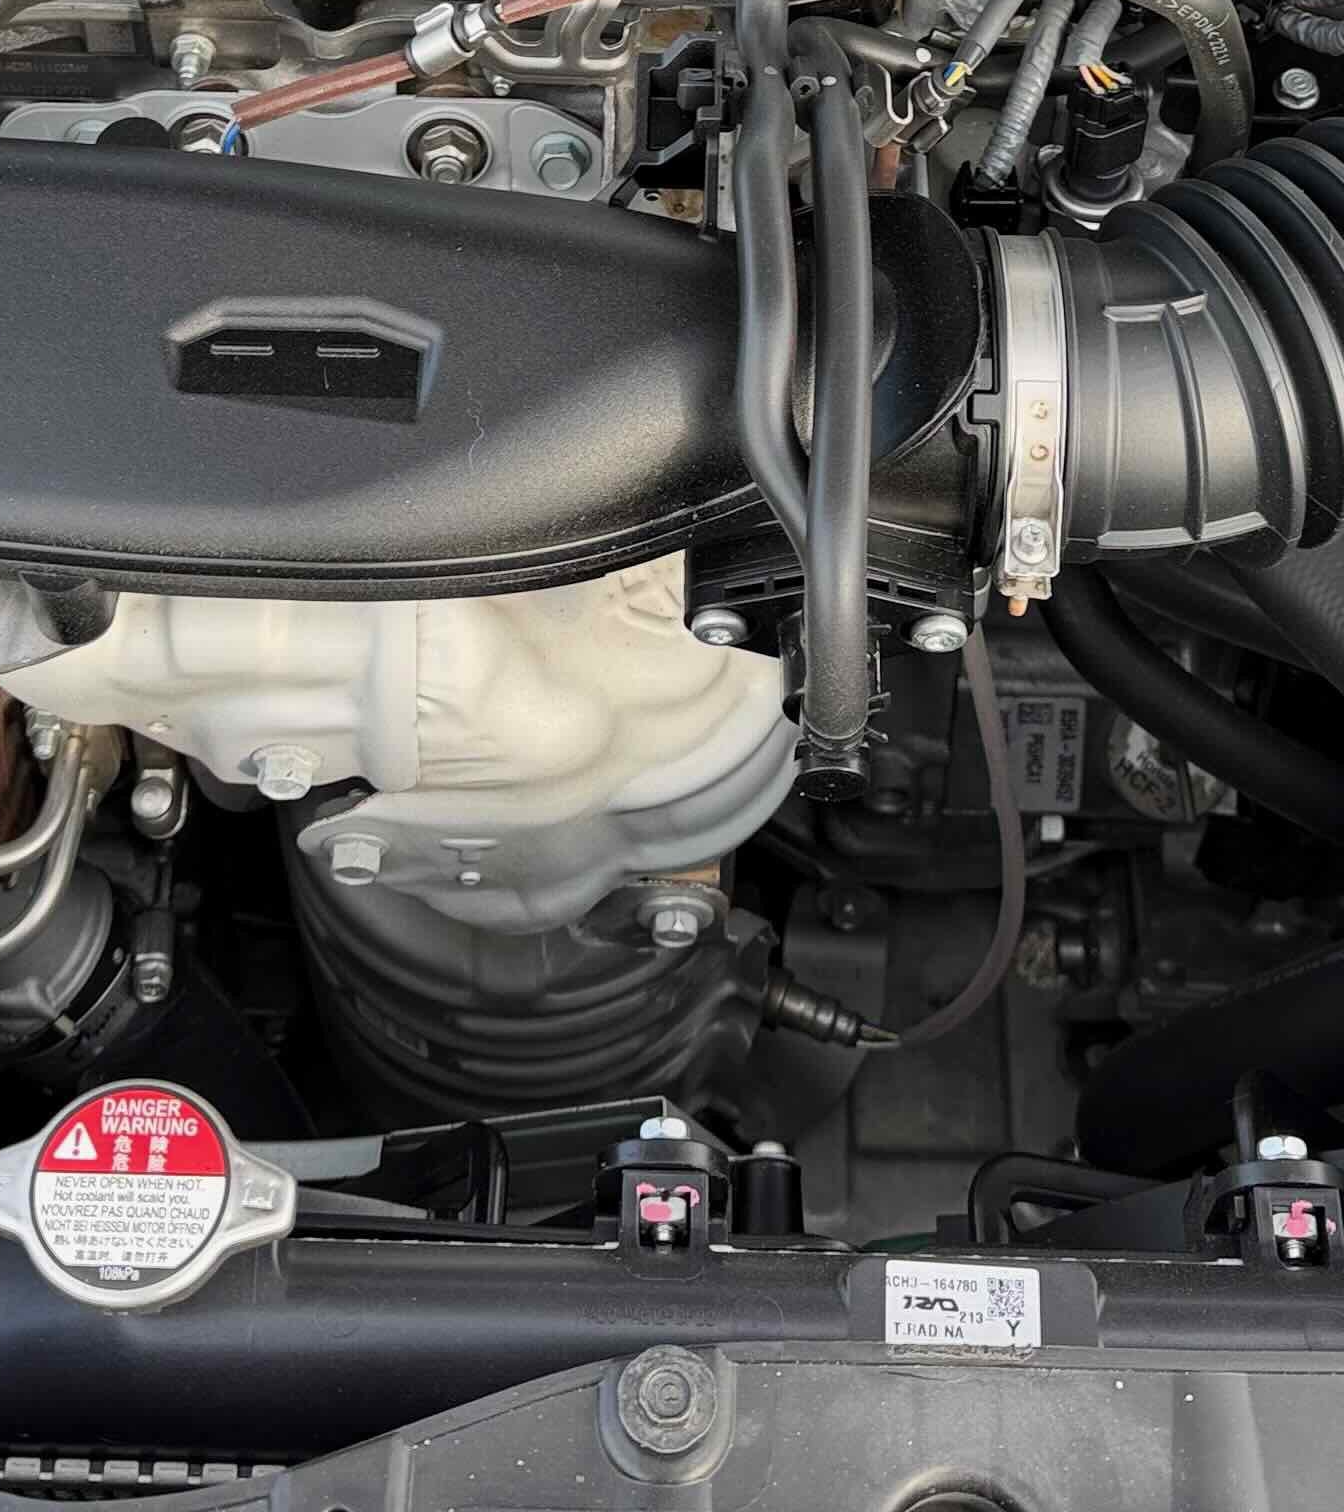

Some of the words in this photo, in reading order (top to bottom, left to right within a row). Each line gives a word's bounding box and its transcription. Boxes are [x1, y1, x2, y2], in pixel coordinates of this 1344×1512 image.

[102, 1098, 183, 1117] DANGER
[101, 1116, 199, 1136] WARNUNG
[55, 1175, 97, 1188] NEVER
[99, 1176, 134, 1189] OPEN
[137, 1177, 174, 1190] WHEN
[53, 1191, 72, 1201] Hot
[76, 1192, 114, 1202] coolant
[117, 1193, 135, 1202] will
[101, 1205, 124, 1217] PAS
[126, 1206, 167, 1219] QUAND
[169, 1207, 210, 1220] CHAUD
[44, 1219, 72, 1231] NICHT
[73, 1220, 88, 1231] BEI
[90, 1221, 130, 1233] HEISSEM
[132, 1221, 164, 1234] MOTOR
[98, 1265, 140, 1281] 108kPa
[944, 1323, 964, 1338] NA
[1006, 1319, 1021, 1337] Y
